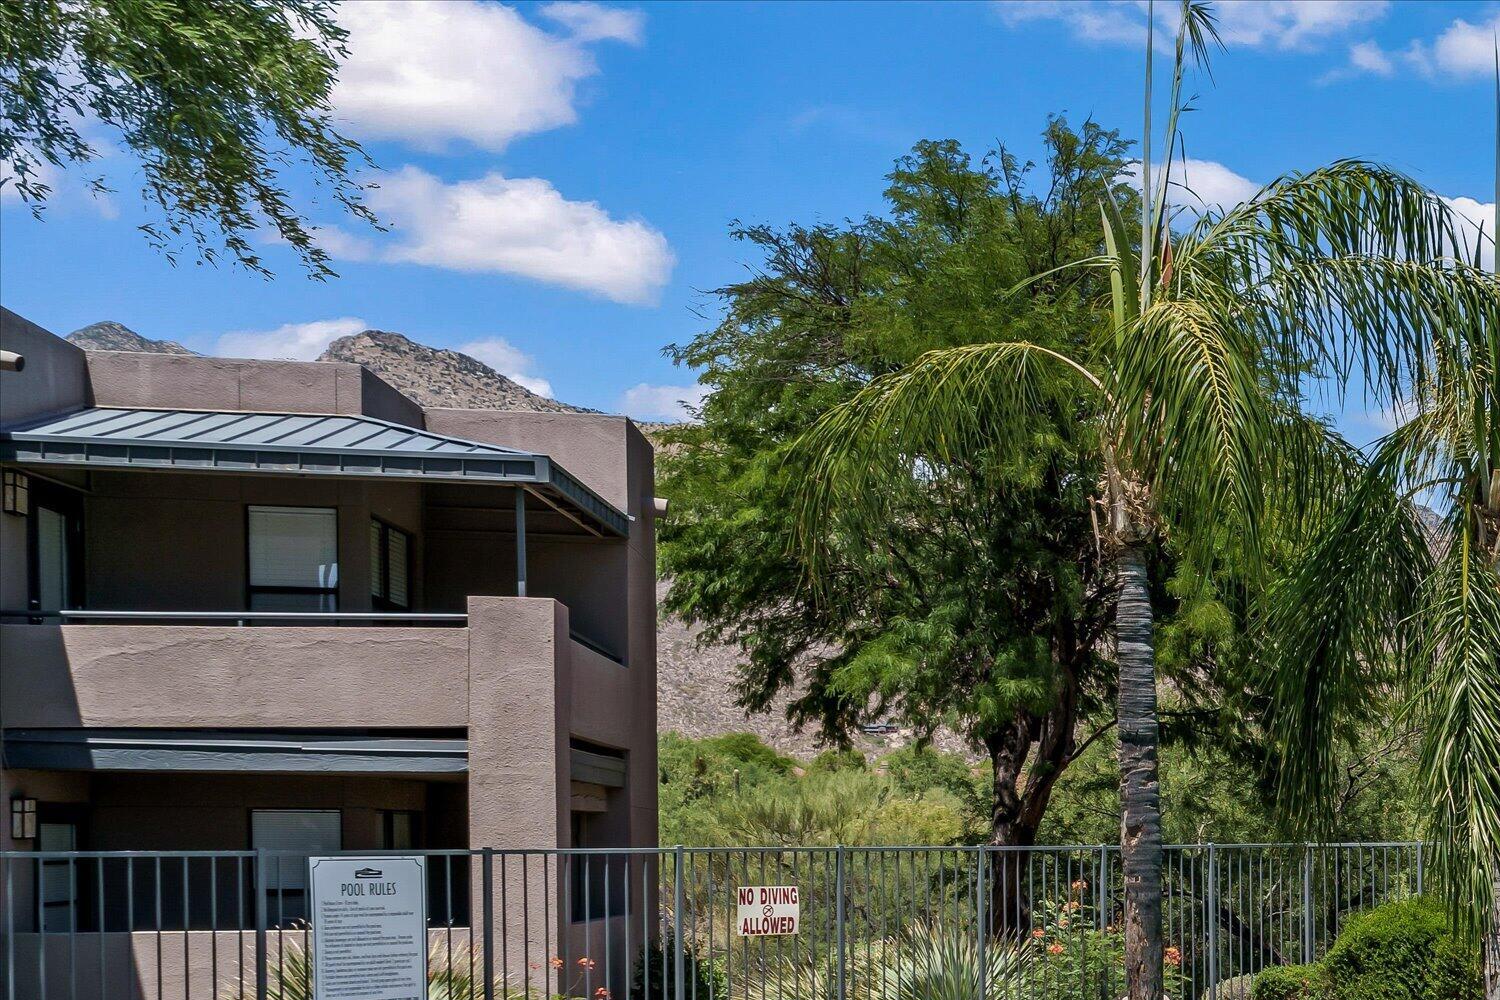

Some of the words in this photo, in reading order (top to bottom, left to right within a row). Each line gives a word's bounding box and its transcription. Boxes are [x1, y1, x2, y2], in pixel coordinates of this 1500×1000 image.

[341, 883, 365, 896] POOL
[369, 882, 397, 896] RULES
[739, 888, 754, 905] NO
[760, 887, 798, 905] DIVING
[742, 916, 795, 934] ALLOWED
